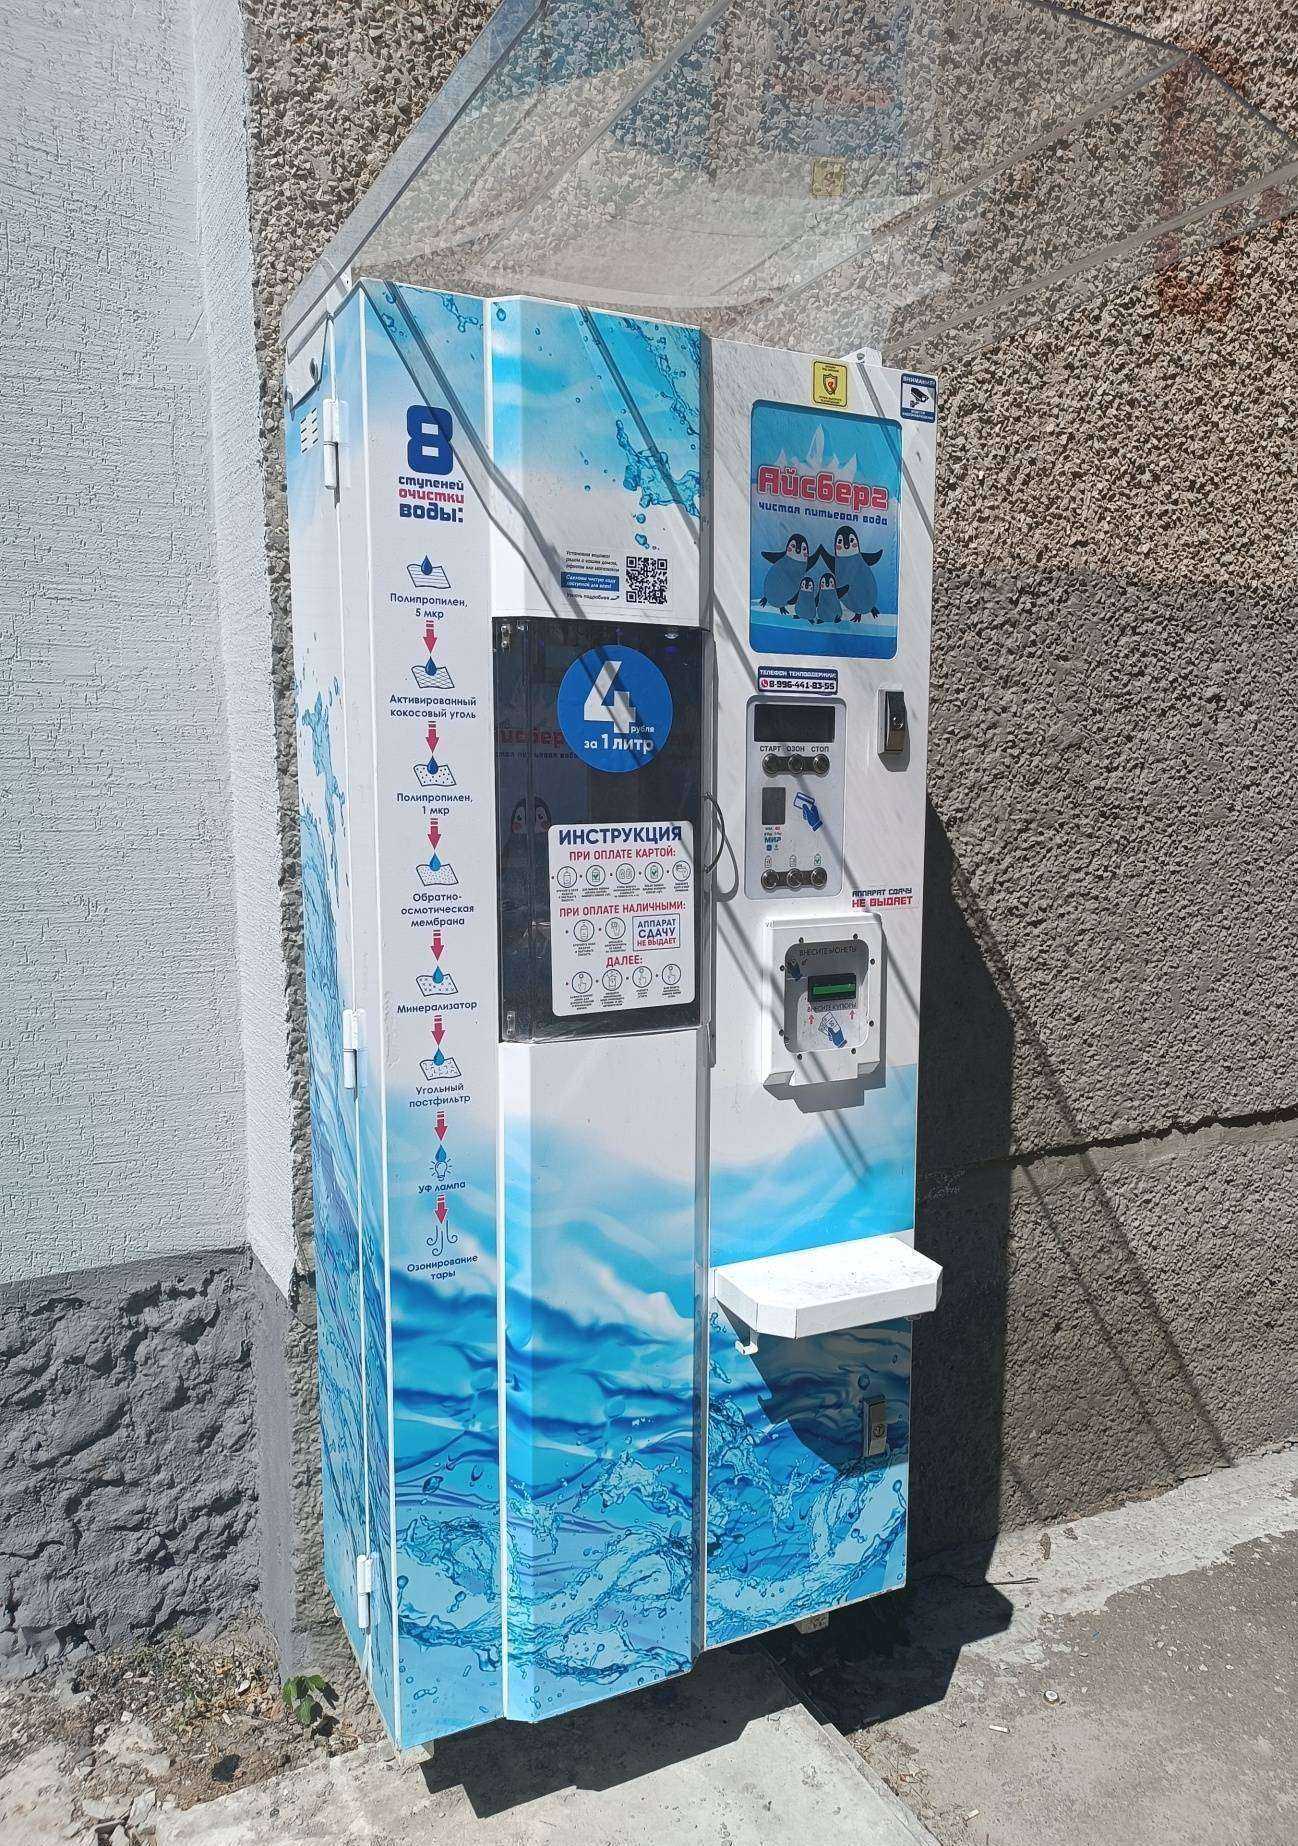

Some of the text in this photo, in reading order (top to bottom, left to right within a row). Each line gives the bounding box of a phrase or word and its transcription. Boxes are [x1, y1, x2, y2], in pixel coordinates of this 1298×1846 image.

[407, 404, 453, 476] 8
[398, 475, 464, 491] ступеней
[757, 466, 888, 512] Айсберг
[398, 488, 464, 504] очистки
[400, 502, 464, 523] воды:
[758, 502, 888, 526] чистая питьевая вода
[390, 593, 468, 607] Полипропилен,
[416, 608, 444, 620] 5 мкр
[390, 694, 476, 706] Активированный
[584, 661, 655, 734] 4 рубля
[390, 709, 476, 719] кокосовый уголь
[584, 734, 654, 754] за 1 литр
[397, 793, 473, 803] Полипропилен,
[422, 806, 450, 816] 1 мкр
[559, 826, 682, 845] ИНСТРУКЦИЯ
[569, 845, 676, 861] ПРИ ОПЛАТЕ КАРТОЙ:
[413, 893, 462, 903] Обратно-
[852, 889, 886, 897] АППАРАТ
[852, 896, 913, 908] НЕ ВЫДАЕТ
[401, 905, 474, 915] осмотическая
[560, 902, 686, 917] ПРИ ОПЛАТЕ НАЛИЧНЫМИ:
[411, 917, 465, 927] мембрана
[637, 919, 676, 928] АППАРАТ
[638, 927, 676, 938] СДАЧУ
[606, 955, 643, 968] ДАЛЕЕ:
[397, 1002, 477, 1013] Минерализатор
[416, 1083, 464, 1095] Угольный
[409, 1095, 471, 1108] постфильтр
[435, 1181, 466, 1192] лампа
[407, 1255, 478, 1272] Озонирование
[431, 1271, 456, 1280] тары
